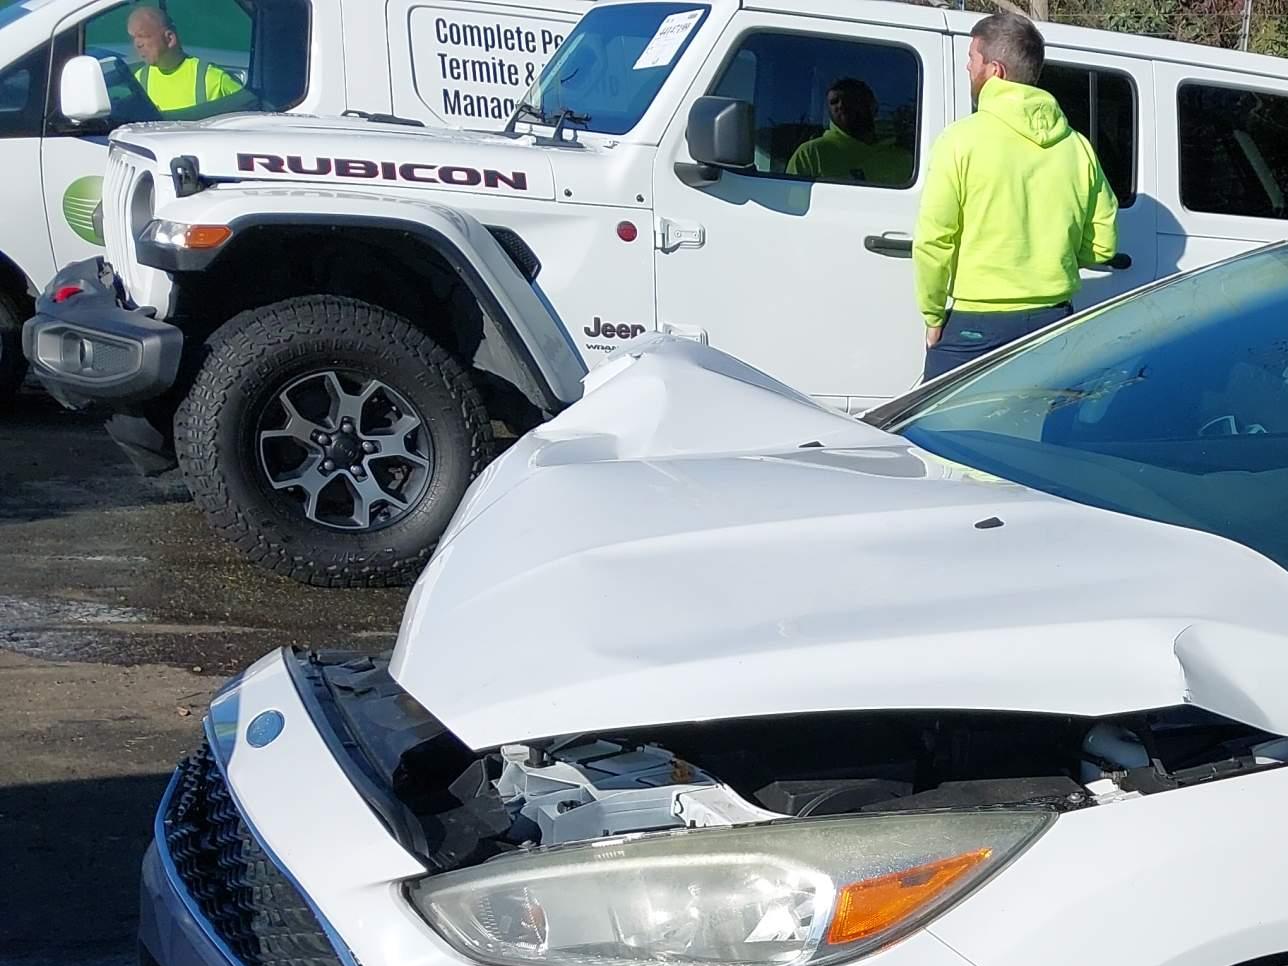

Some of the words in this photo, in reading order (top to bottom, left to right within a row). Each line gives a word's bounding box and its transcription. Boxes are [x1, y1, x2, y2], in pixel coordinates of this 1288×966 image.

[435, 17, 537, 53] Complete
[437, 53, 519, 87] Termite
[525, 62, 536, 88] &
[236, 152, 528, 191] RUBICON
